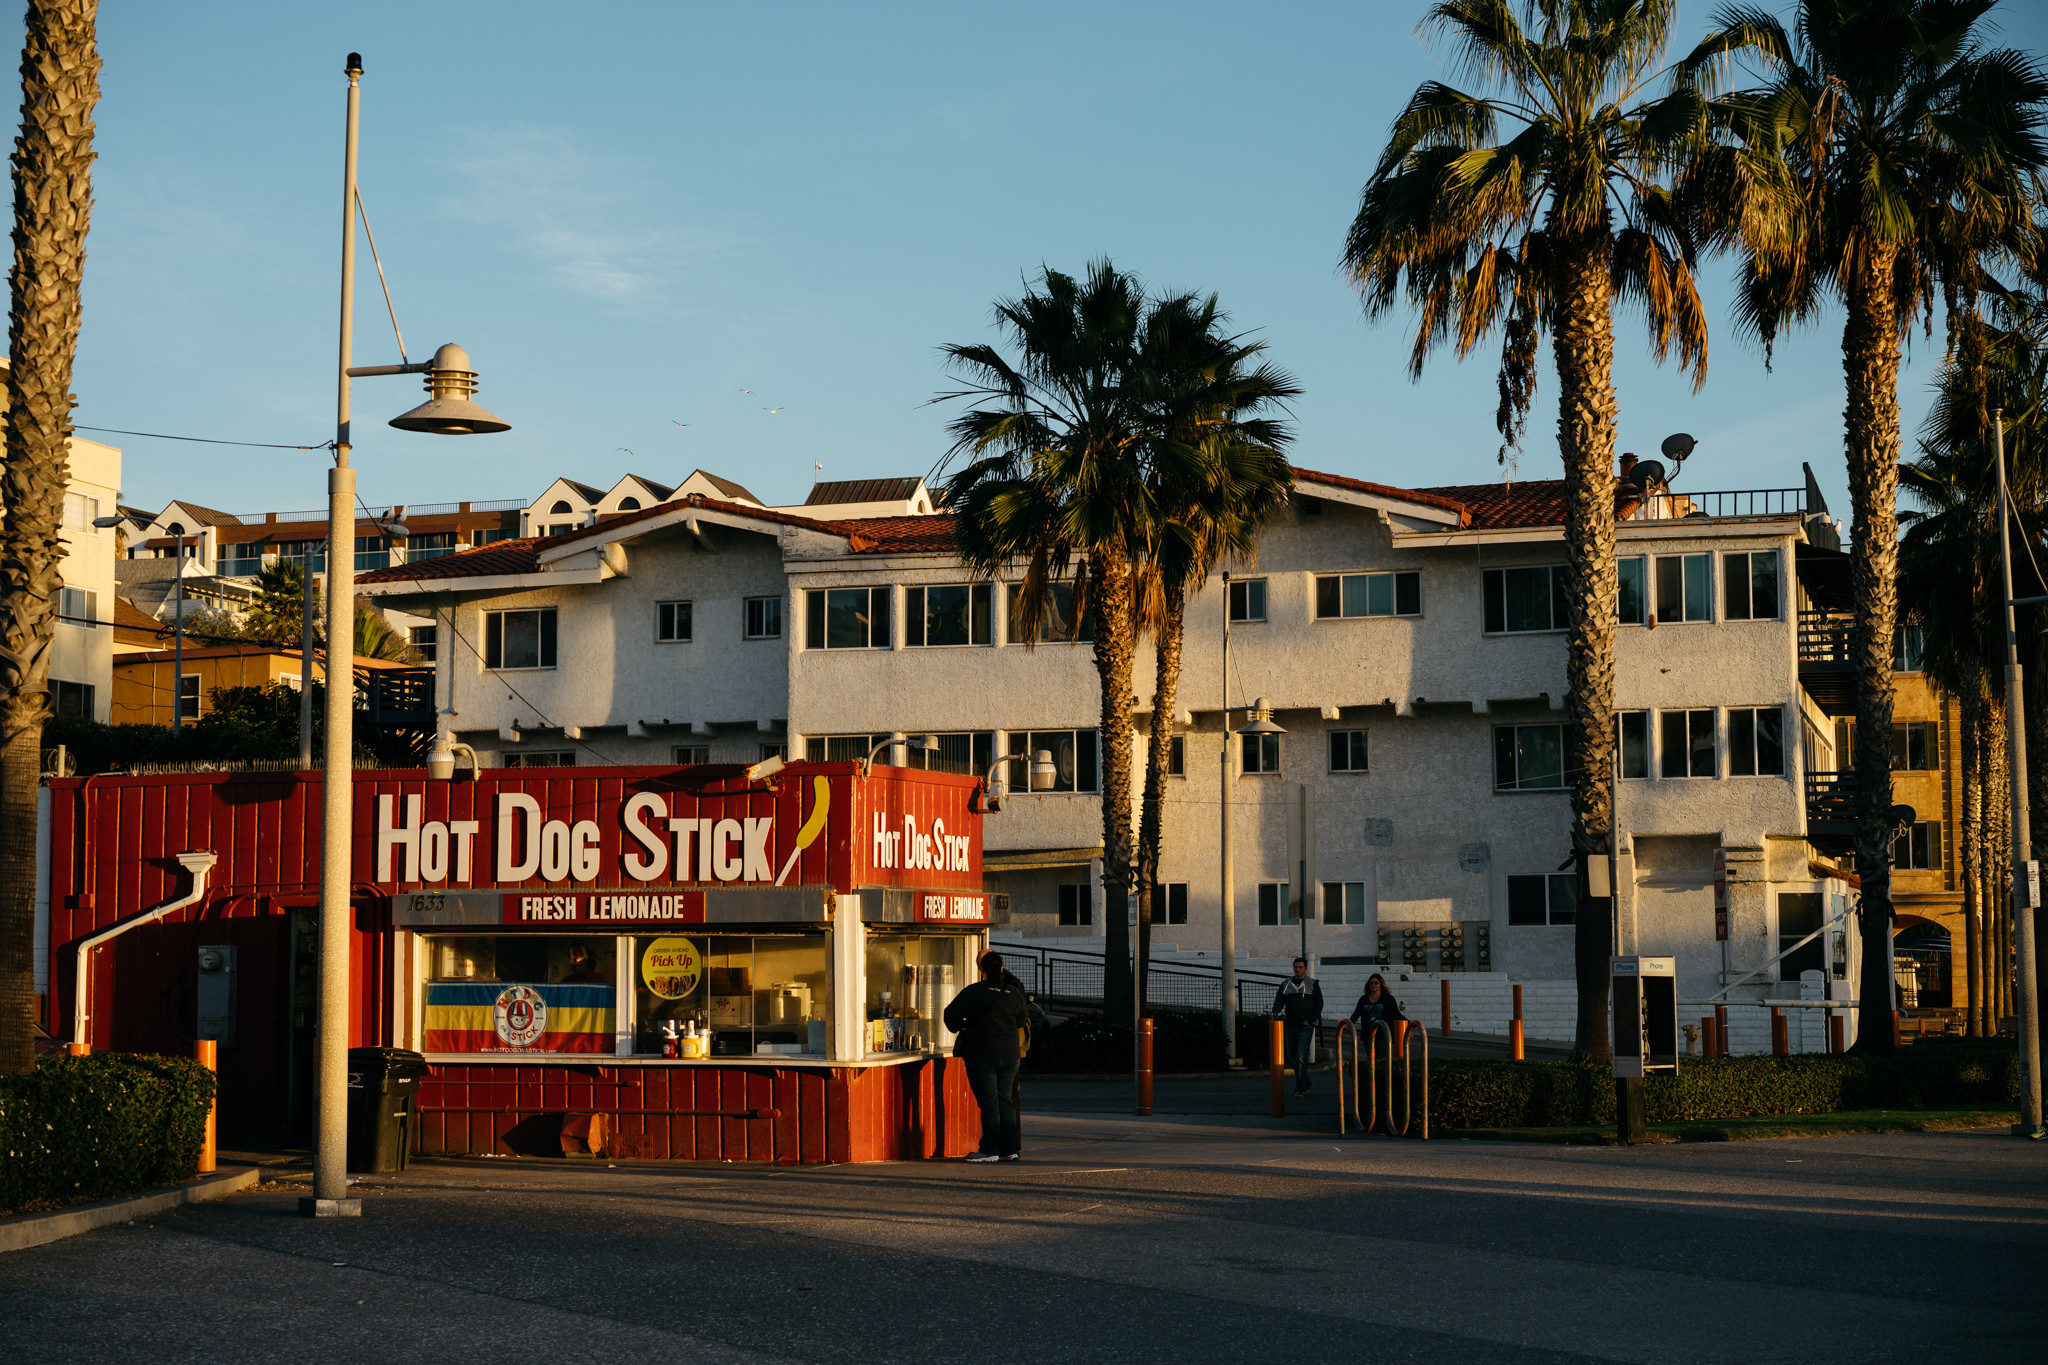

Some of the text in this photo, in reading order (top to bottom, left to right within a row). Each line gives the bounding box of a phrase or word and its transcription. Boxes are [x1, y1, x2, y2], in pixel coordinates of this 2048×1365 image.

[408, 895, 446, 911] 1633
[522, 895, 684, 920] FRESH LEMONADE
[924, 895, 984, 920] FRESH LEMONADE
[650, 954, 693, 969] Pick Up
[497, 988, 544, 1011] HOT DOG
[510, 1025, 539, 1042] STICK
